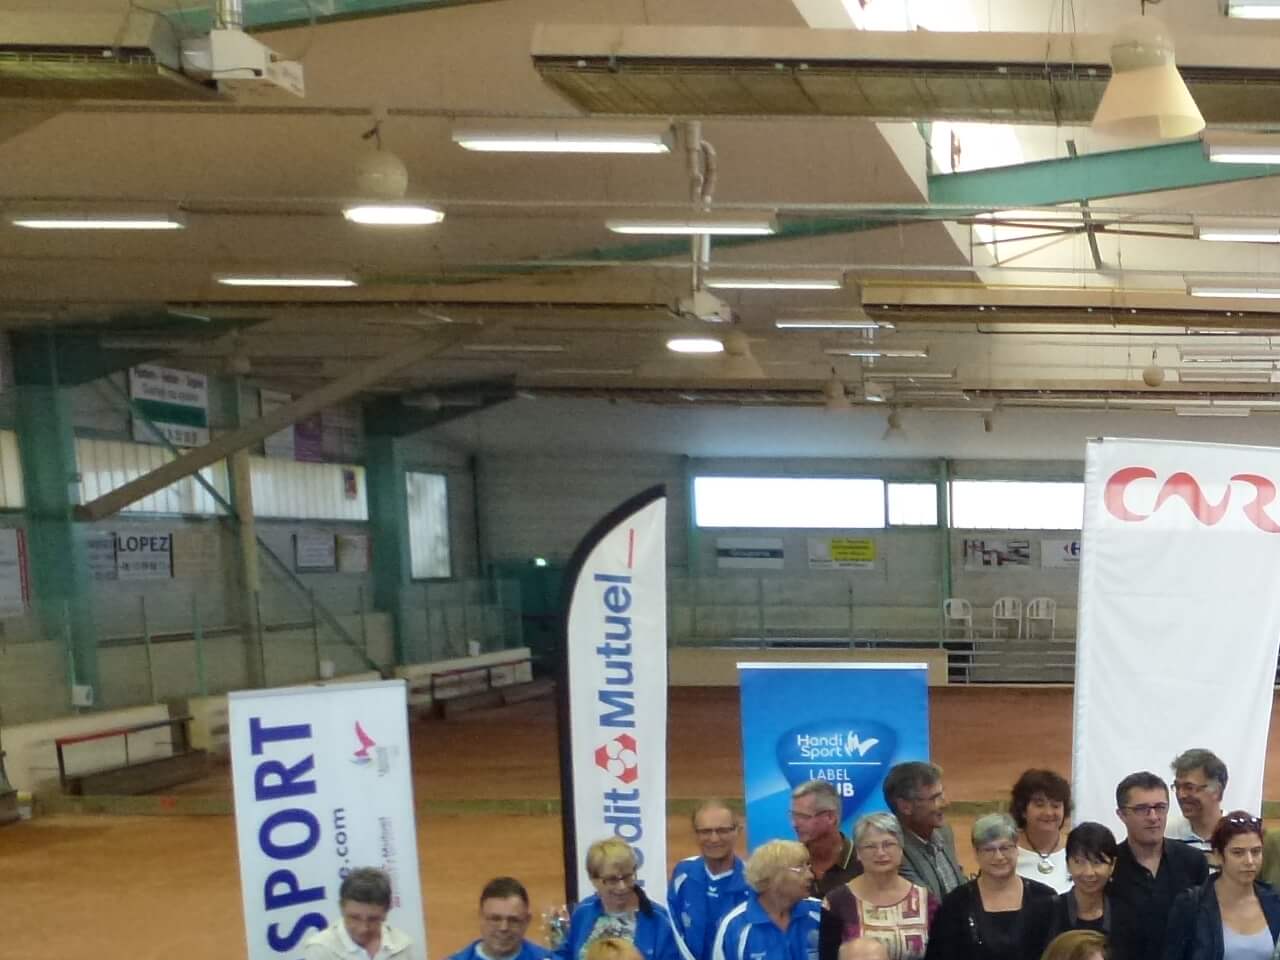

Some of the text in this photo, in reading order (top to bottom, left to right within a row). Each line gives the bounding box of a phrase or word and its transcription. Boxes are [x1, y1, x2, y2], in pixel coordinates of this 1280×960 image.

[118, 536, 169, 552] LOPEZ
[593, 573, 636, 729] Mutuel
[796, 733, 843, 747] Handi
[800, 745, 843, 760] Sport
[809, 768, 851, 781] LABEL
